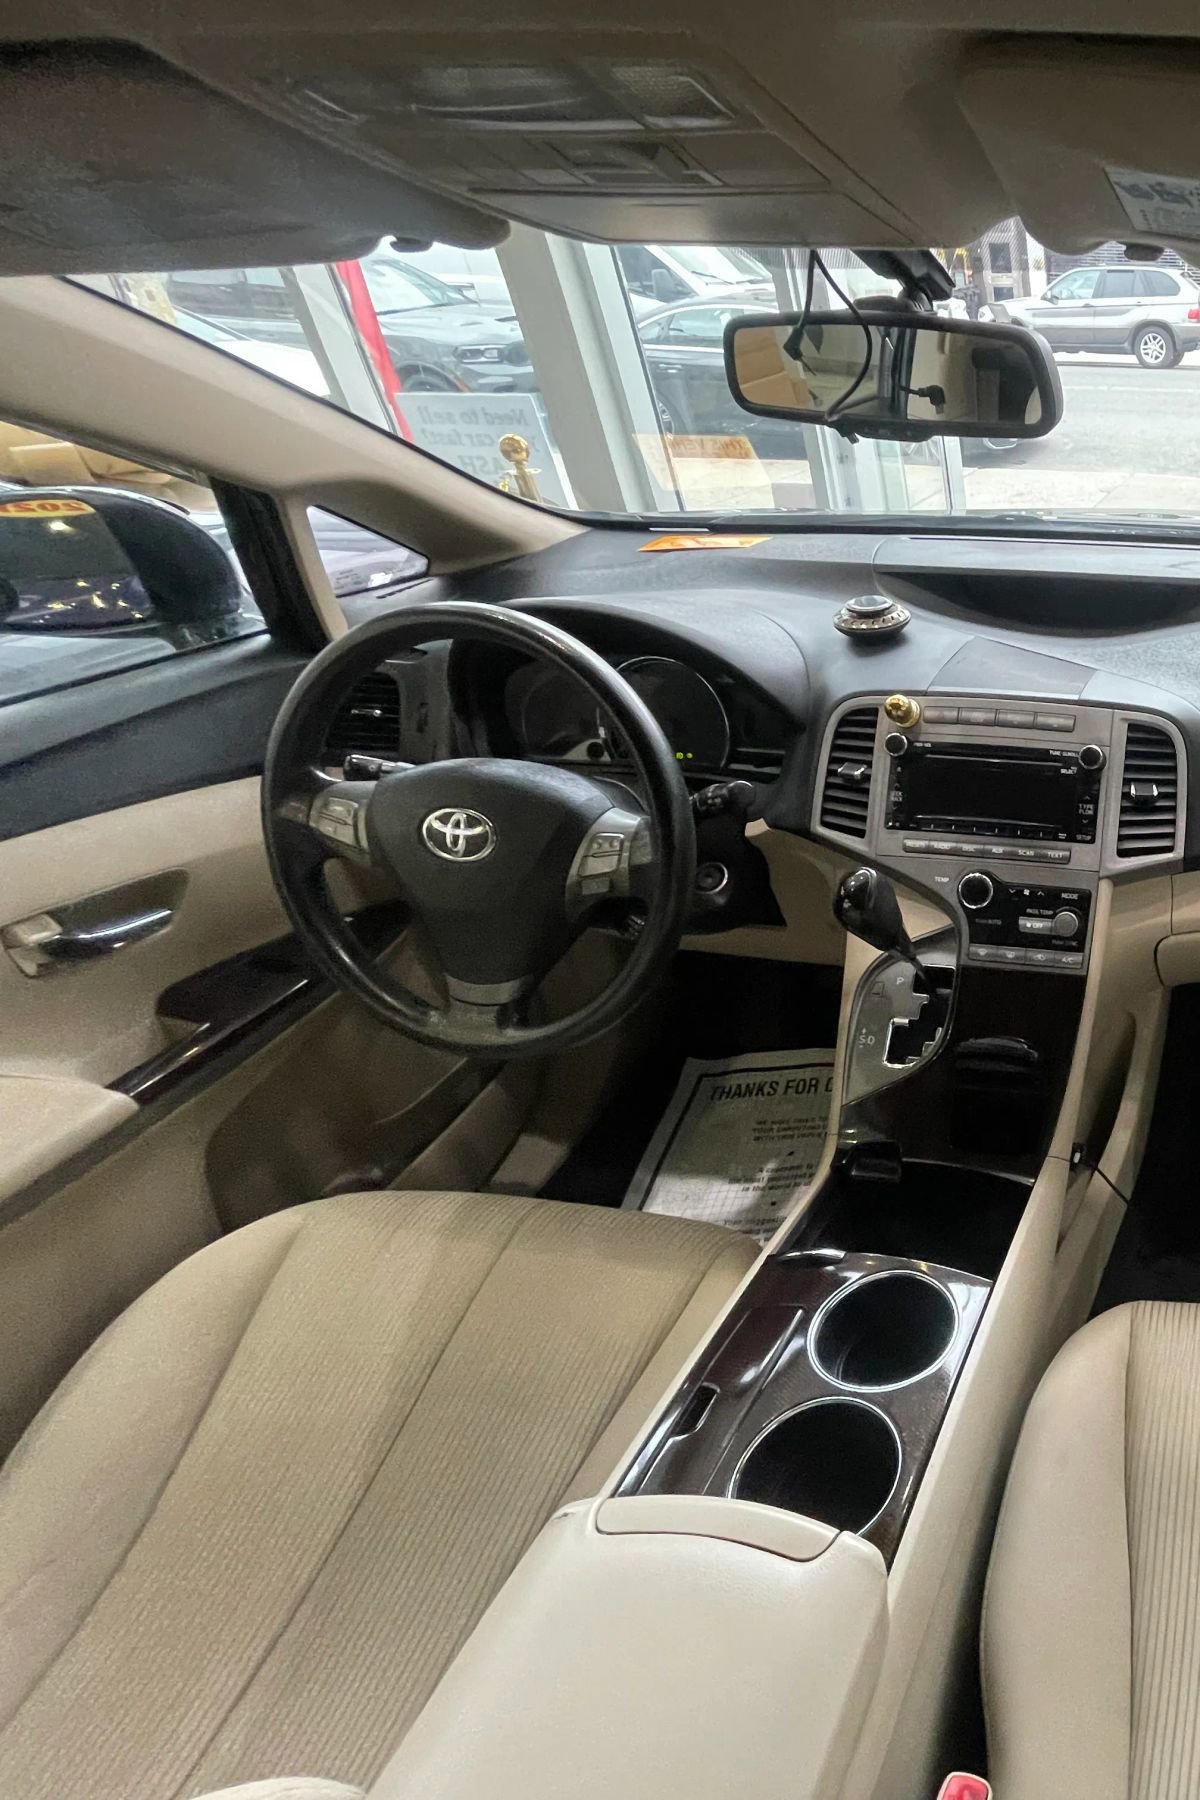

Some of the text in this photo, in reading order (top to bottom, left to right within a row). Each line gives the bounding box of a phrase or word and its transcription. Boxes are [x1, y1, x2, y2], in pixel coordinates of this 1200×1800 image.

[1018, 849, 1034, 857] SCAN
[1061, 892, 1079, 900] MODE
[1062, 956, 1074, 964] A/C
[896, 976, 904, 985] P
[867, 1035, 875, 1045] D
[709, 1080, 779, 1101] THANKS
[783, 1077, 819, 1096] FOR
